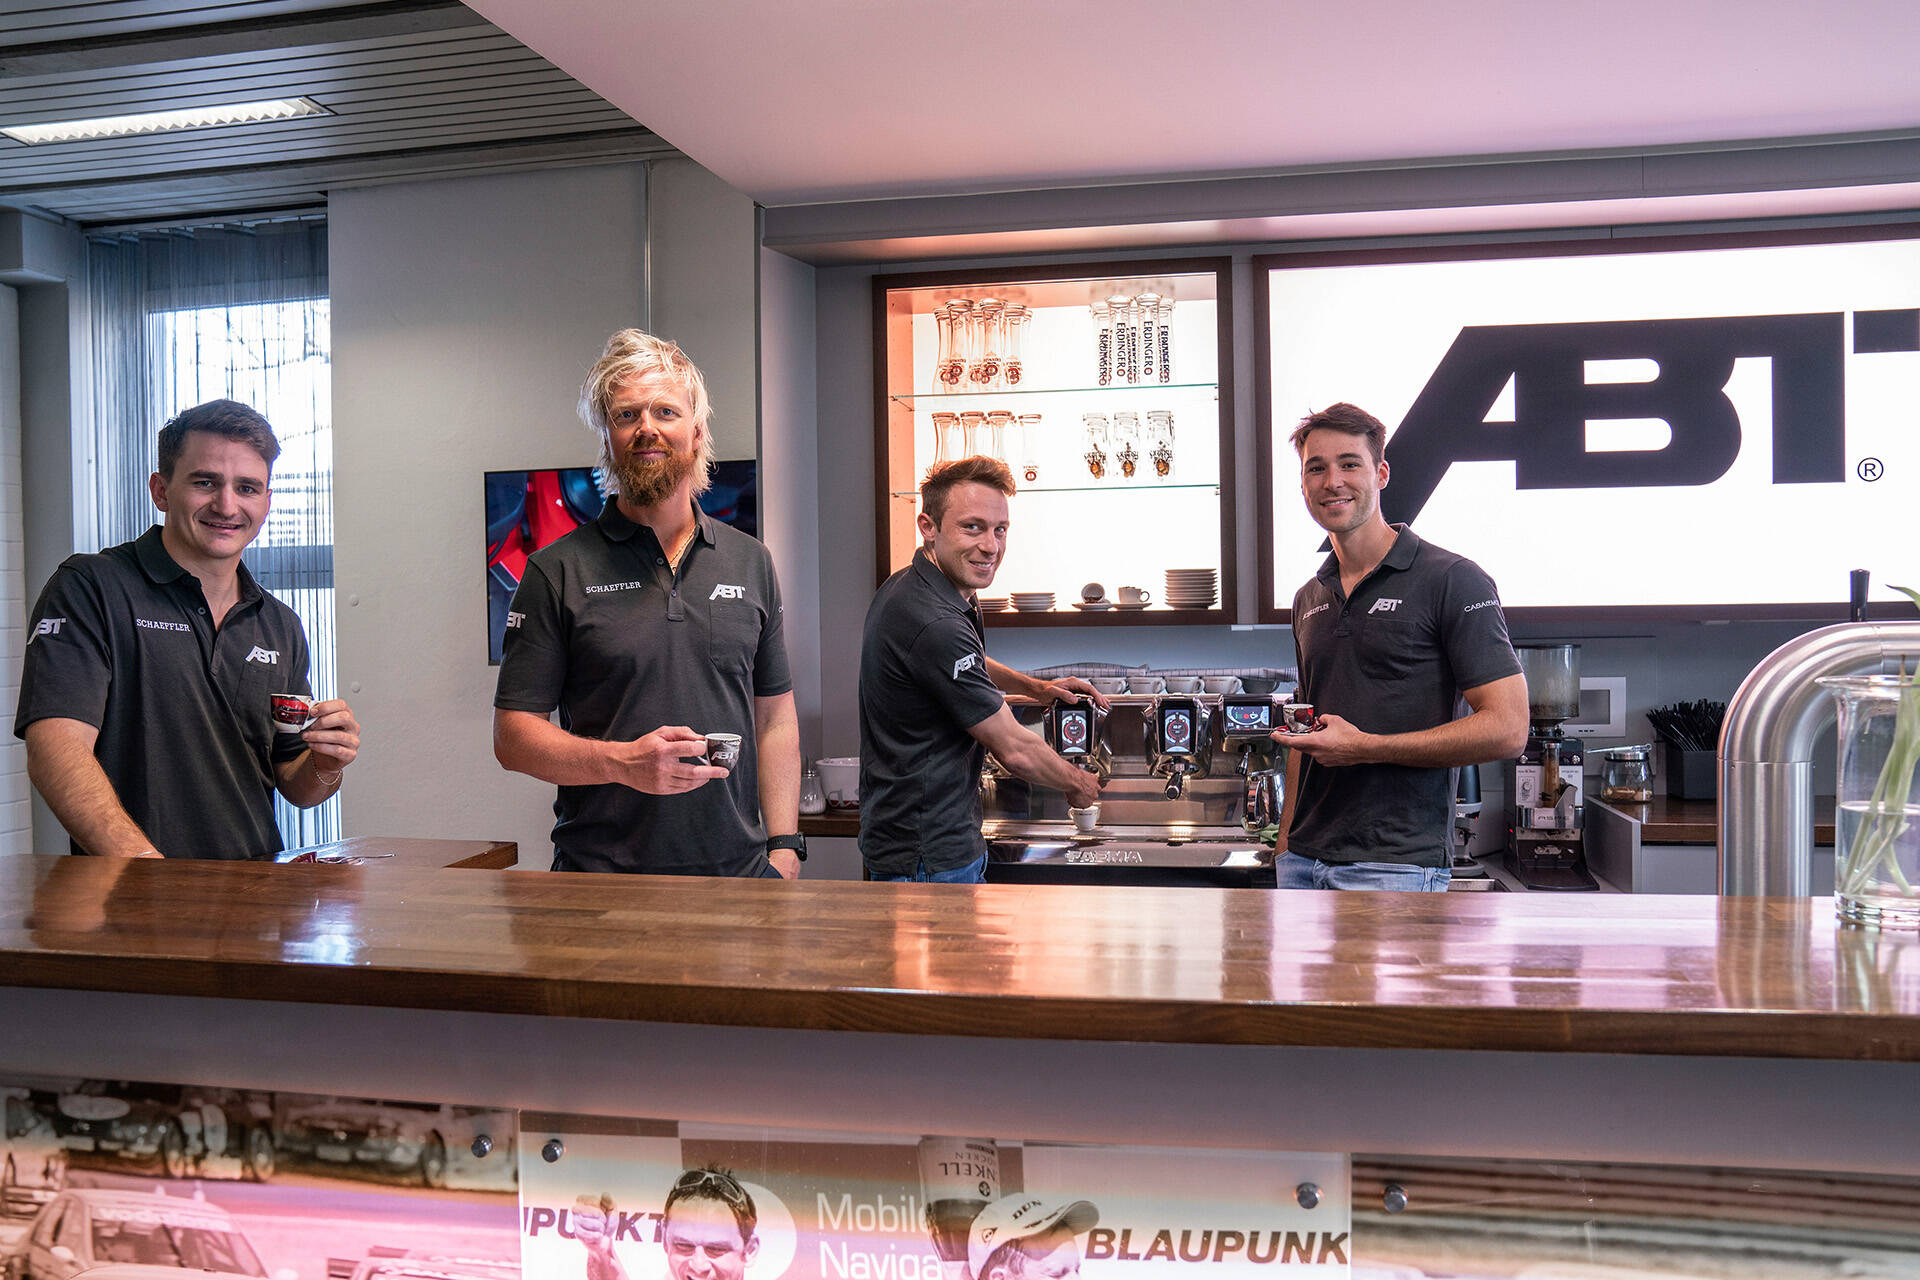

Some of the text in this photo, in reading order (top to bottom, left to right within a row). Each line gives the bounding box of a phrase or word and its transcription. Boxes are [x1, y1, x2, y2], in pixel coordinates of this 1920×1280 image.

[1317, 309, 1920, 552] ABT
[585, 581, 642, 594] SCHAEFFLER
[709, 583, 746, 601] ABT
[1368, 598, 1402, 614] ABT
[136, 618, 191, 632] SCHAEFFLER
[506, 611, 526, 629] BT
[27, 617, 67, 646] ABT
[245, 645, 281, 665] ABT
[953, 652, 977, 680] ABT
[1085, 1228, 1349, 1265] BLAUPUNK
